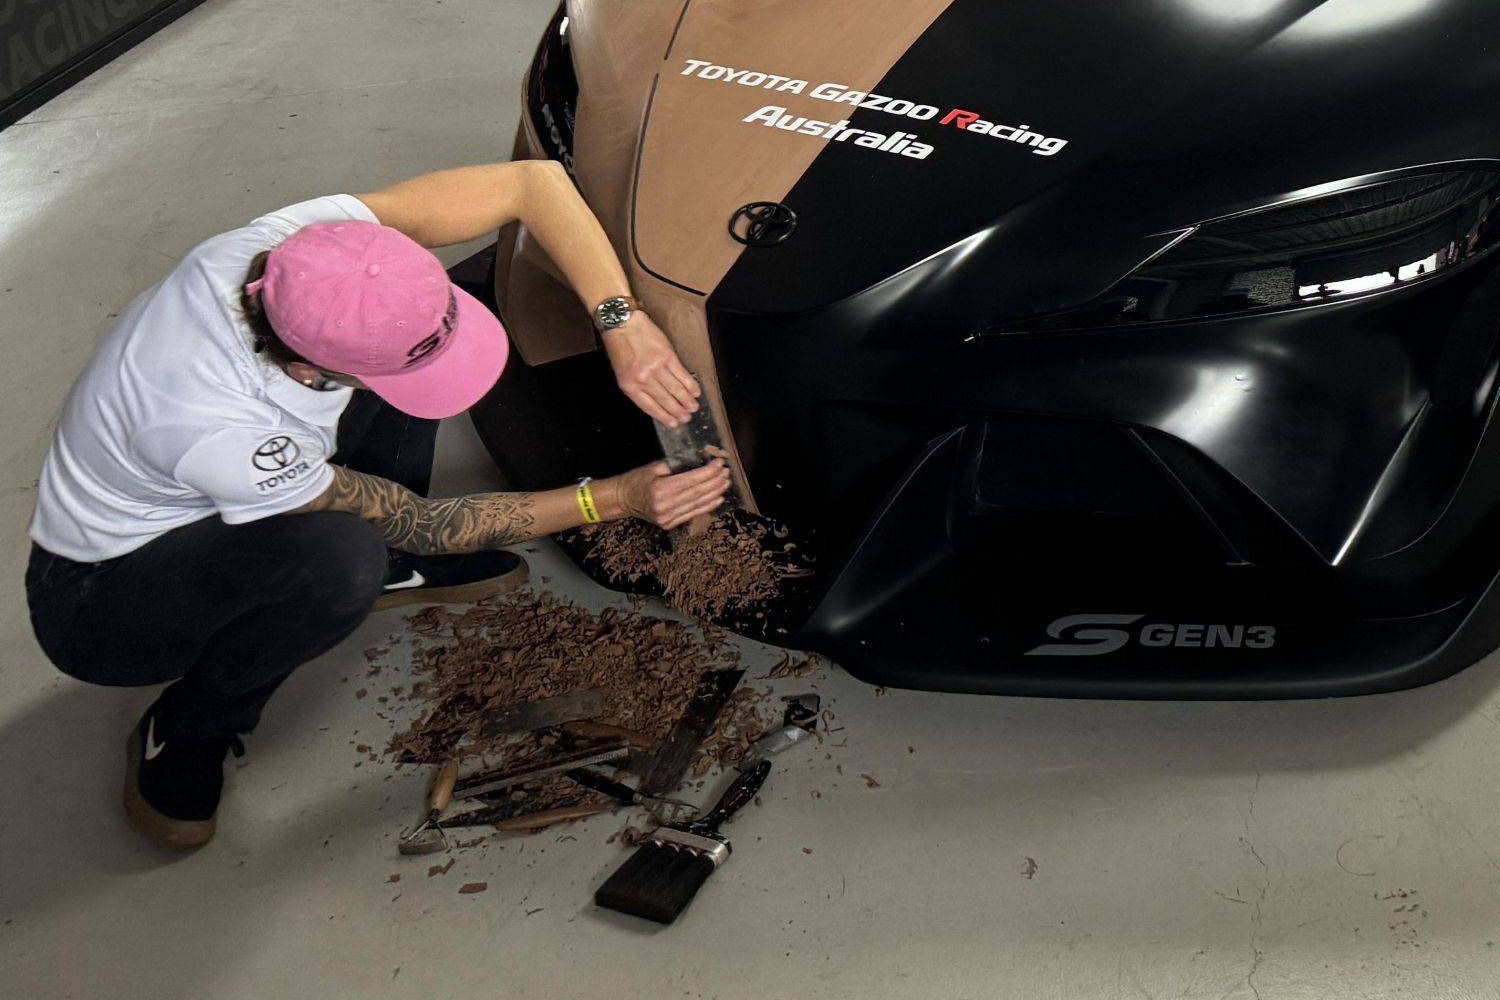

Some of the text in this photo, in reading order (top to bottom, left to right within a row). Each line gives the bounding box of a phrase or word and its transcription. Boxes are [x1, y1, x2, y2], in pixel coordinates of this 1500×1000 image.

[680, 59, 1069, 157] TOYOTA GAZOO Racing
[741, 104, 936, 160] Australia
[255, 460, 311, 493] TOYOTA
[1139, 623, 1277, 649] GEN3
